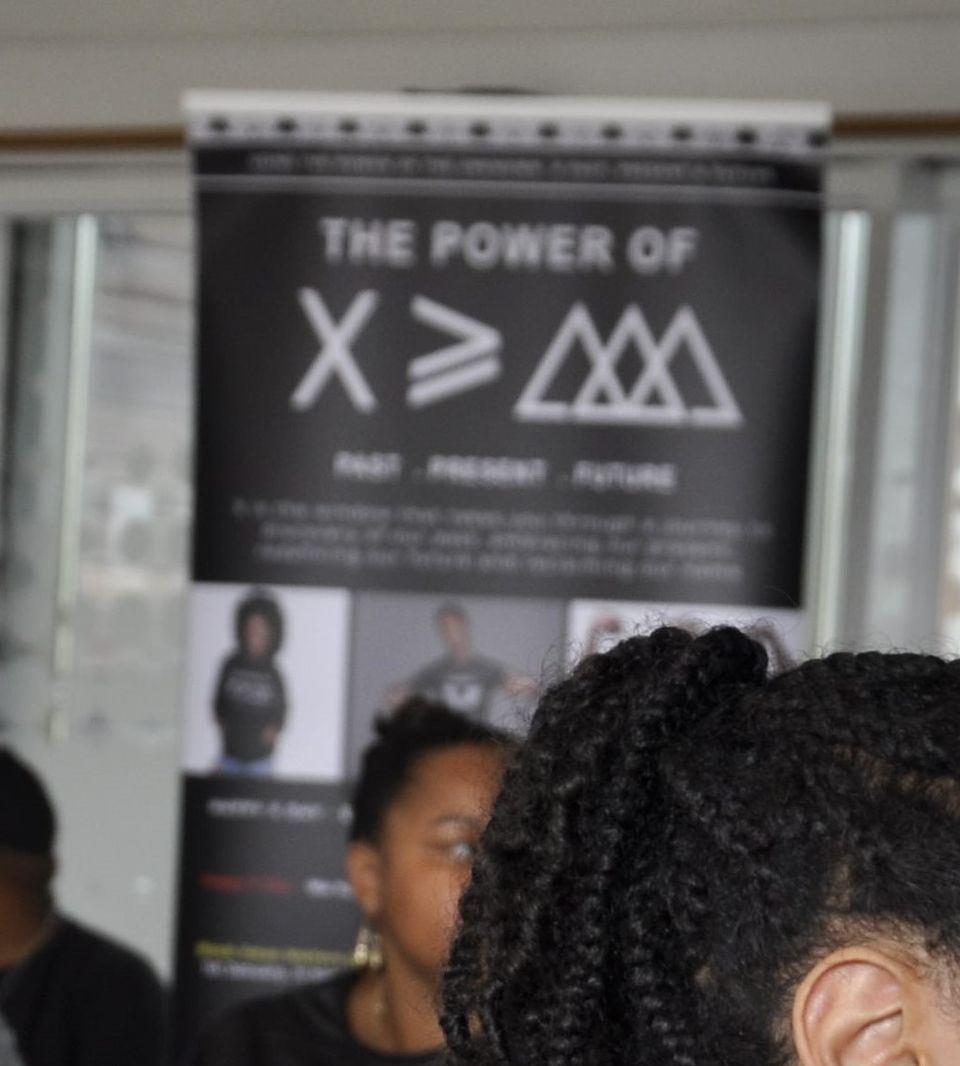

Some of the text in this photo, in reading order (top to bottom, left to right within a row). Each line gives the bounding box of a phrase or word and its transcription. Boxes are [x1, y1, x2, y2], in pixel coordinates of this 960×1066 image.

[321, 217, 698, 274] THE POWER OF
[333, 451, 676, 493] PAST PRESENT FUTURE
